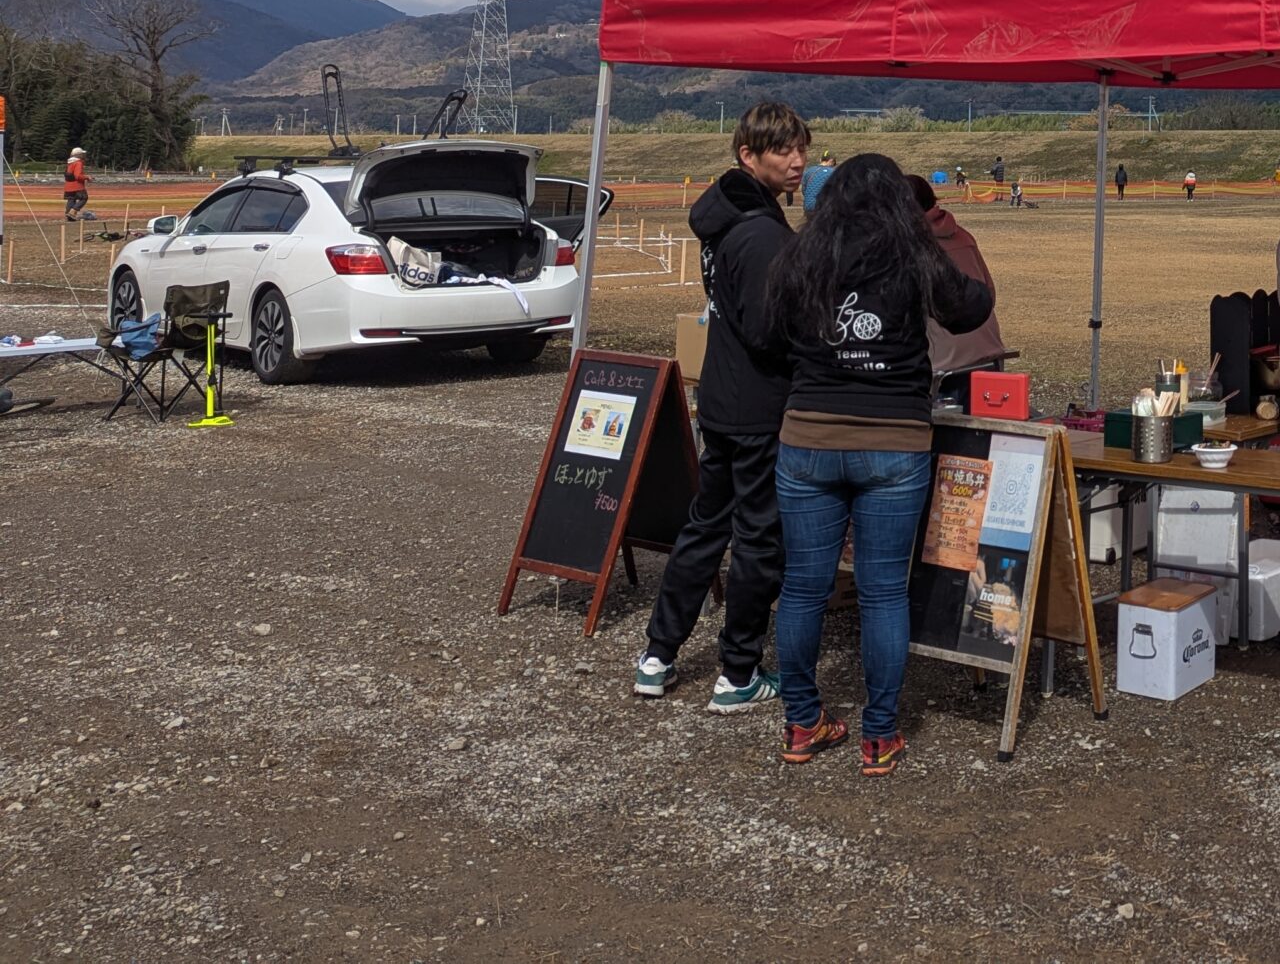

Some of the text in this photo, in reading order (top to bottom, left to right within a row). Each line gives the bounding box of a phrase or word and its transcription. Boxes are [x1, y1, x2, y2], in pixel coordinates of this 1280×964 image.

[554, 463, 613, 491] ほっとゆず
[980, 588, 1012, 606] home
